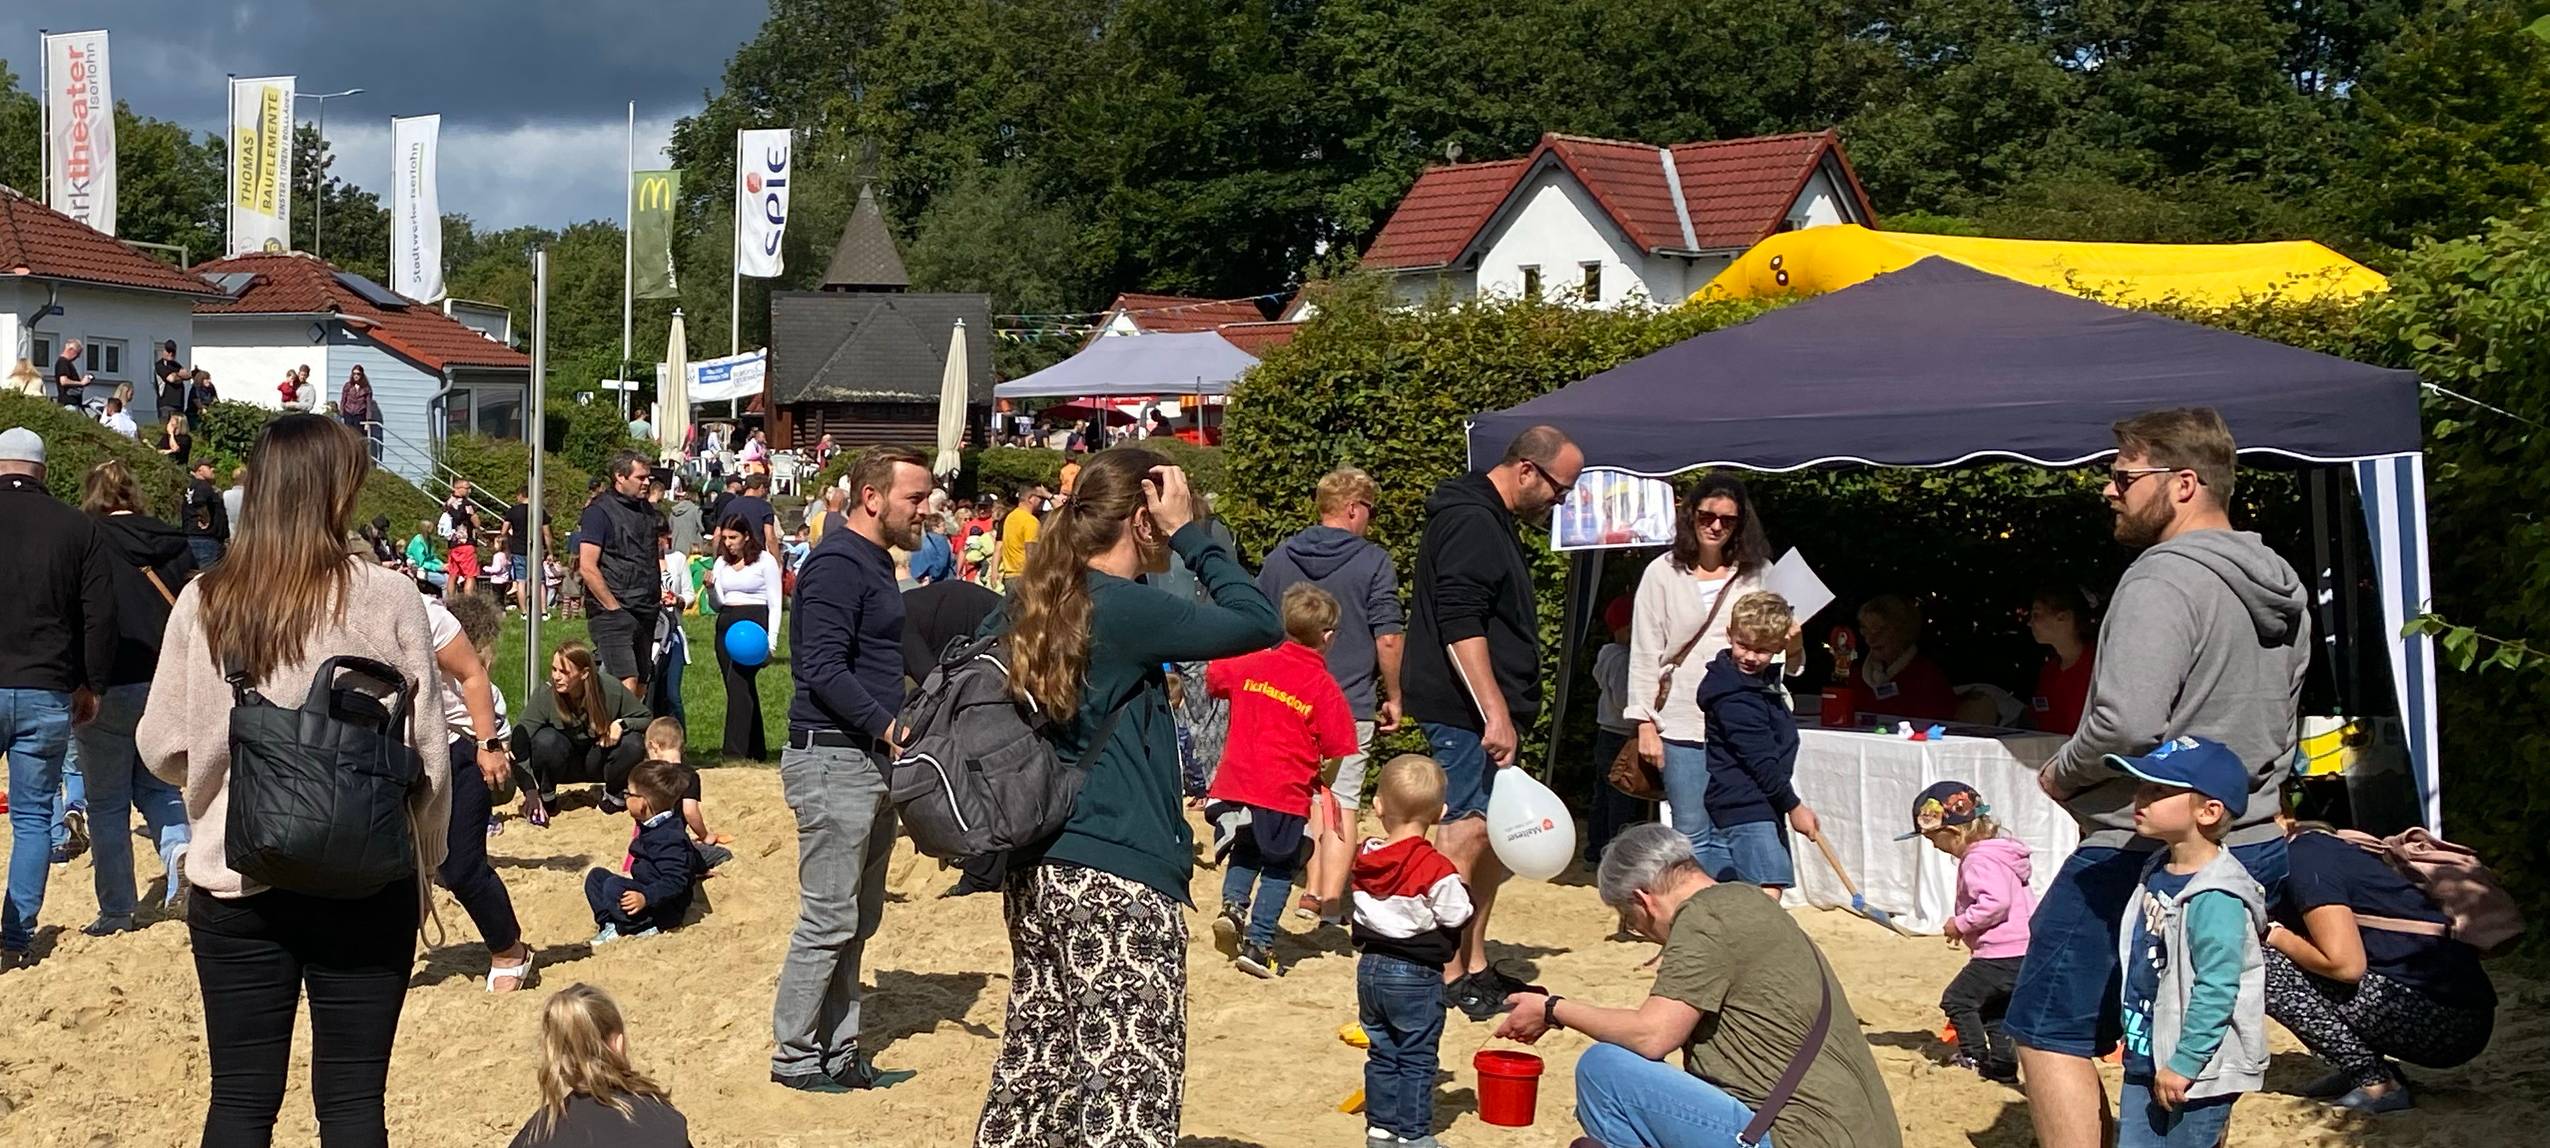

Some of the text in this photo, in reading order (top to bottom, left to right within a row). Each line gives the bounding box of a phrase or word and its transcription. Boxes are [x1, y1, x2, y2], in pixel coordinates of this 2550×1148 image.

[66, 45, 91, 224] arktheater
[240, 135, 254, 202] THOMAS
[261, 92, 278, 210] BAUELEMENTE
[278, 148, 289, 176] TÜREN
[277, 181, 287, 221] FENSTER
[409, 141, 422, 284] Stadtwerke Iserlohn
[764, 146, 787, 257] SPIE
